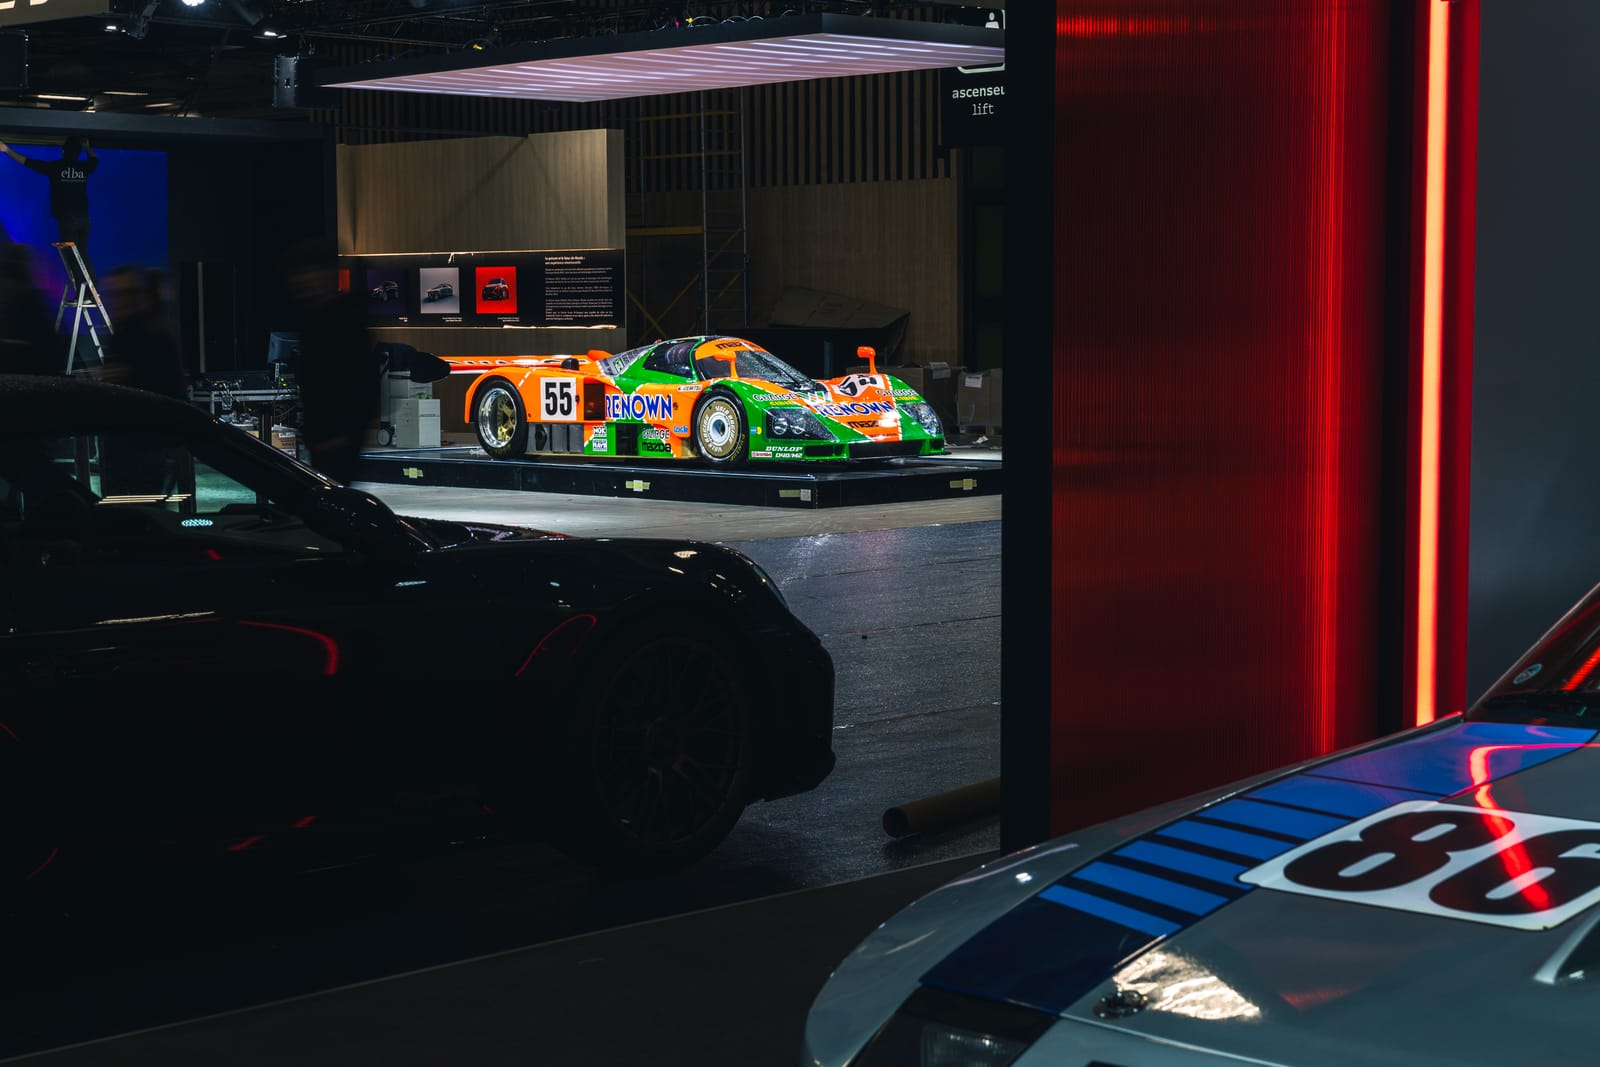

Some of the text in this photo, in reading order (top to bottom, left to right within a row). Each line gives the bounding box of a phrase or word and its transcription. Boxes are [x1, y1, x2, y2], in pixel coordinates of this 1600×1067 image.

[972, 103, 994, 115] lift
[545, 382, 572, 416] 55
[604, 394, 673, 420] RENOWN
[814, 400, 895, 416] RENOWN
[642, 442, 672, 453] mazda
[1284, 810, 1600, 915] 86
